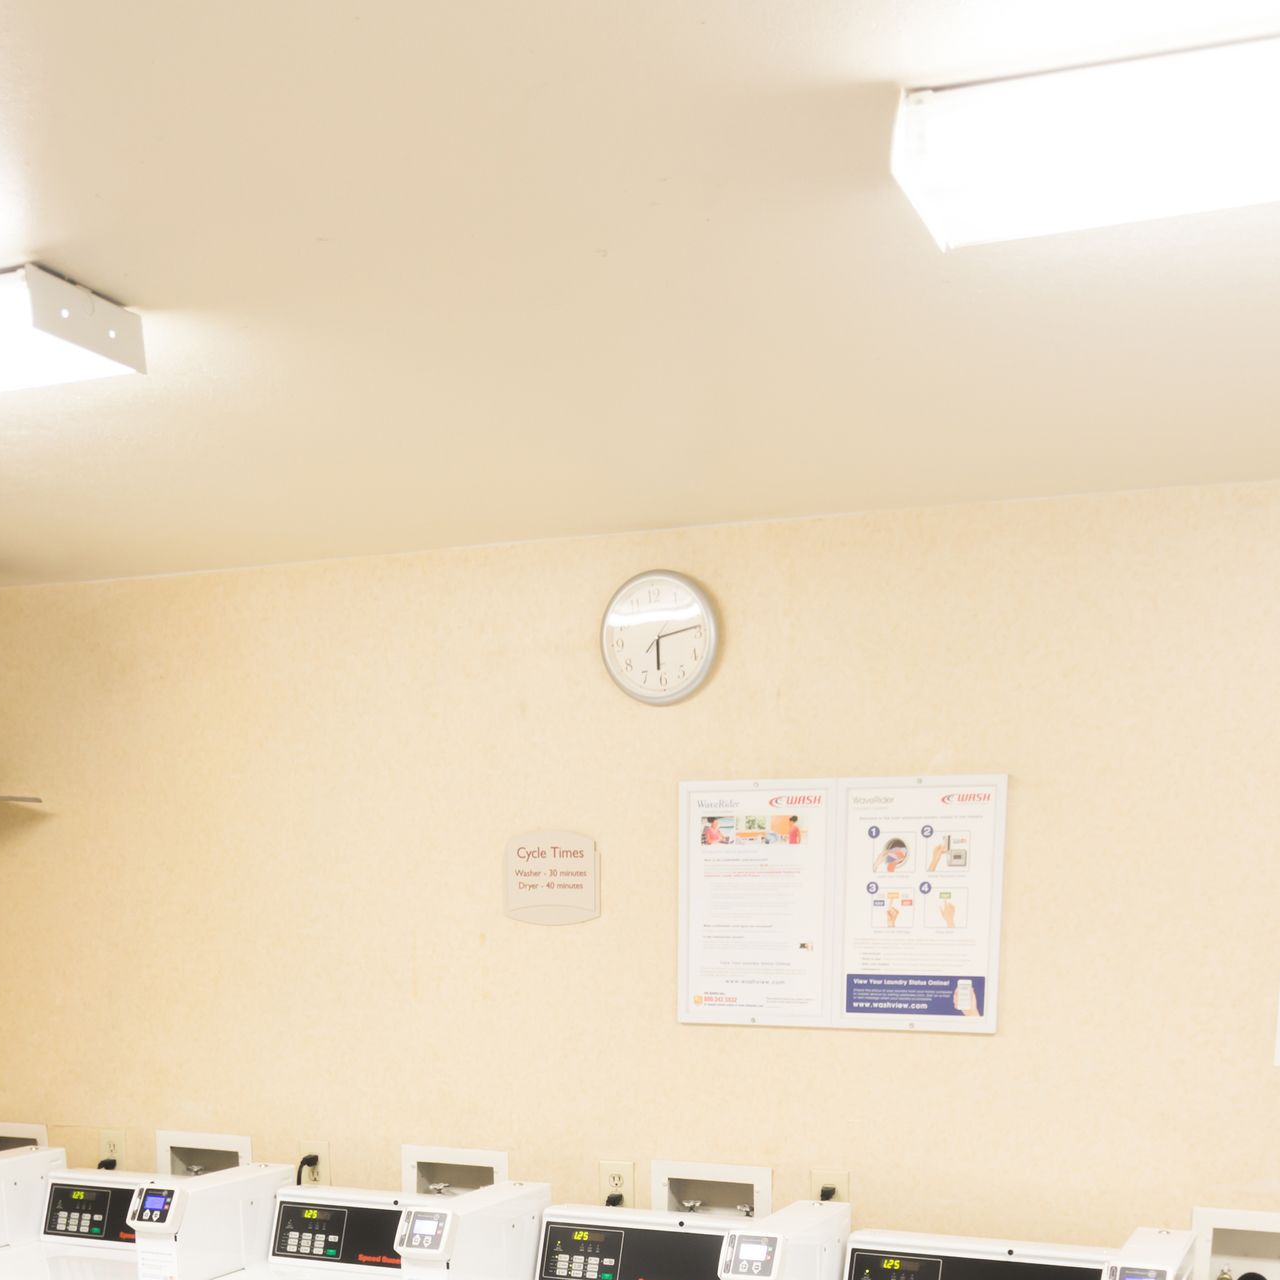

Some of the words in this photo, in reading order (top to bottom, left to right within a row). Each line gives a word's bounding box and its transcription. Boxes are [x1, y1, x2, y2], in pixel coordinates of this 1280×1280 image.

[648, 588, 660, 604] 12
[616, 639, 624, 652] 9
[625, 659, 633, 671] 8
[641, 670, 648, 684] 7
[660, 672, 667, 687] 6
[786, 795, 822, 805] WASH
[957, 793, 991, 803] WASH
[517, 847, 546, 861] Cycle
[550, 846, 584, 858] Times
[515, 869, 541, 877] Washer
[549, 869, 557, 877] 30
[560, 869, 587, 877] minutes
[518, 882, 539, 891] Dryer
[357, 1253, 381, 1263] Speed
[883, 1260, 900, 1269] 1.25
